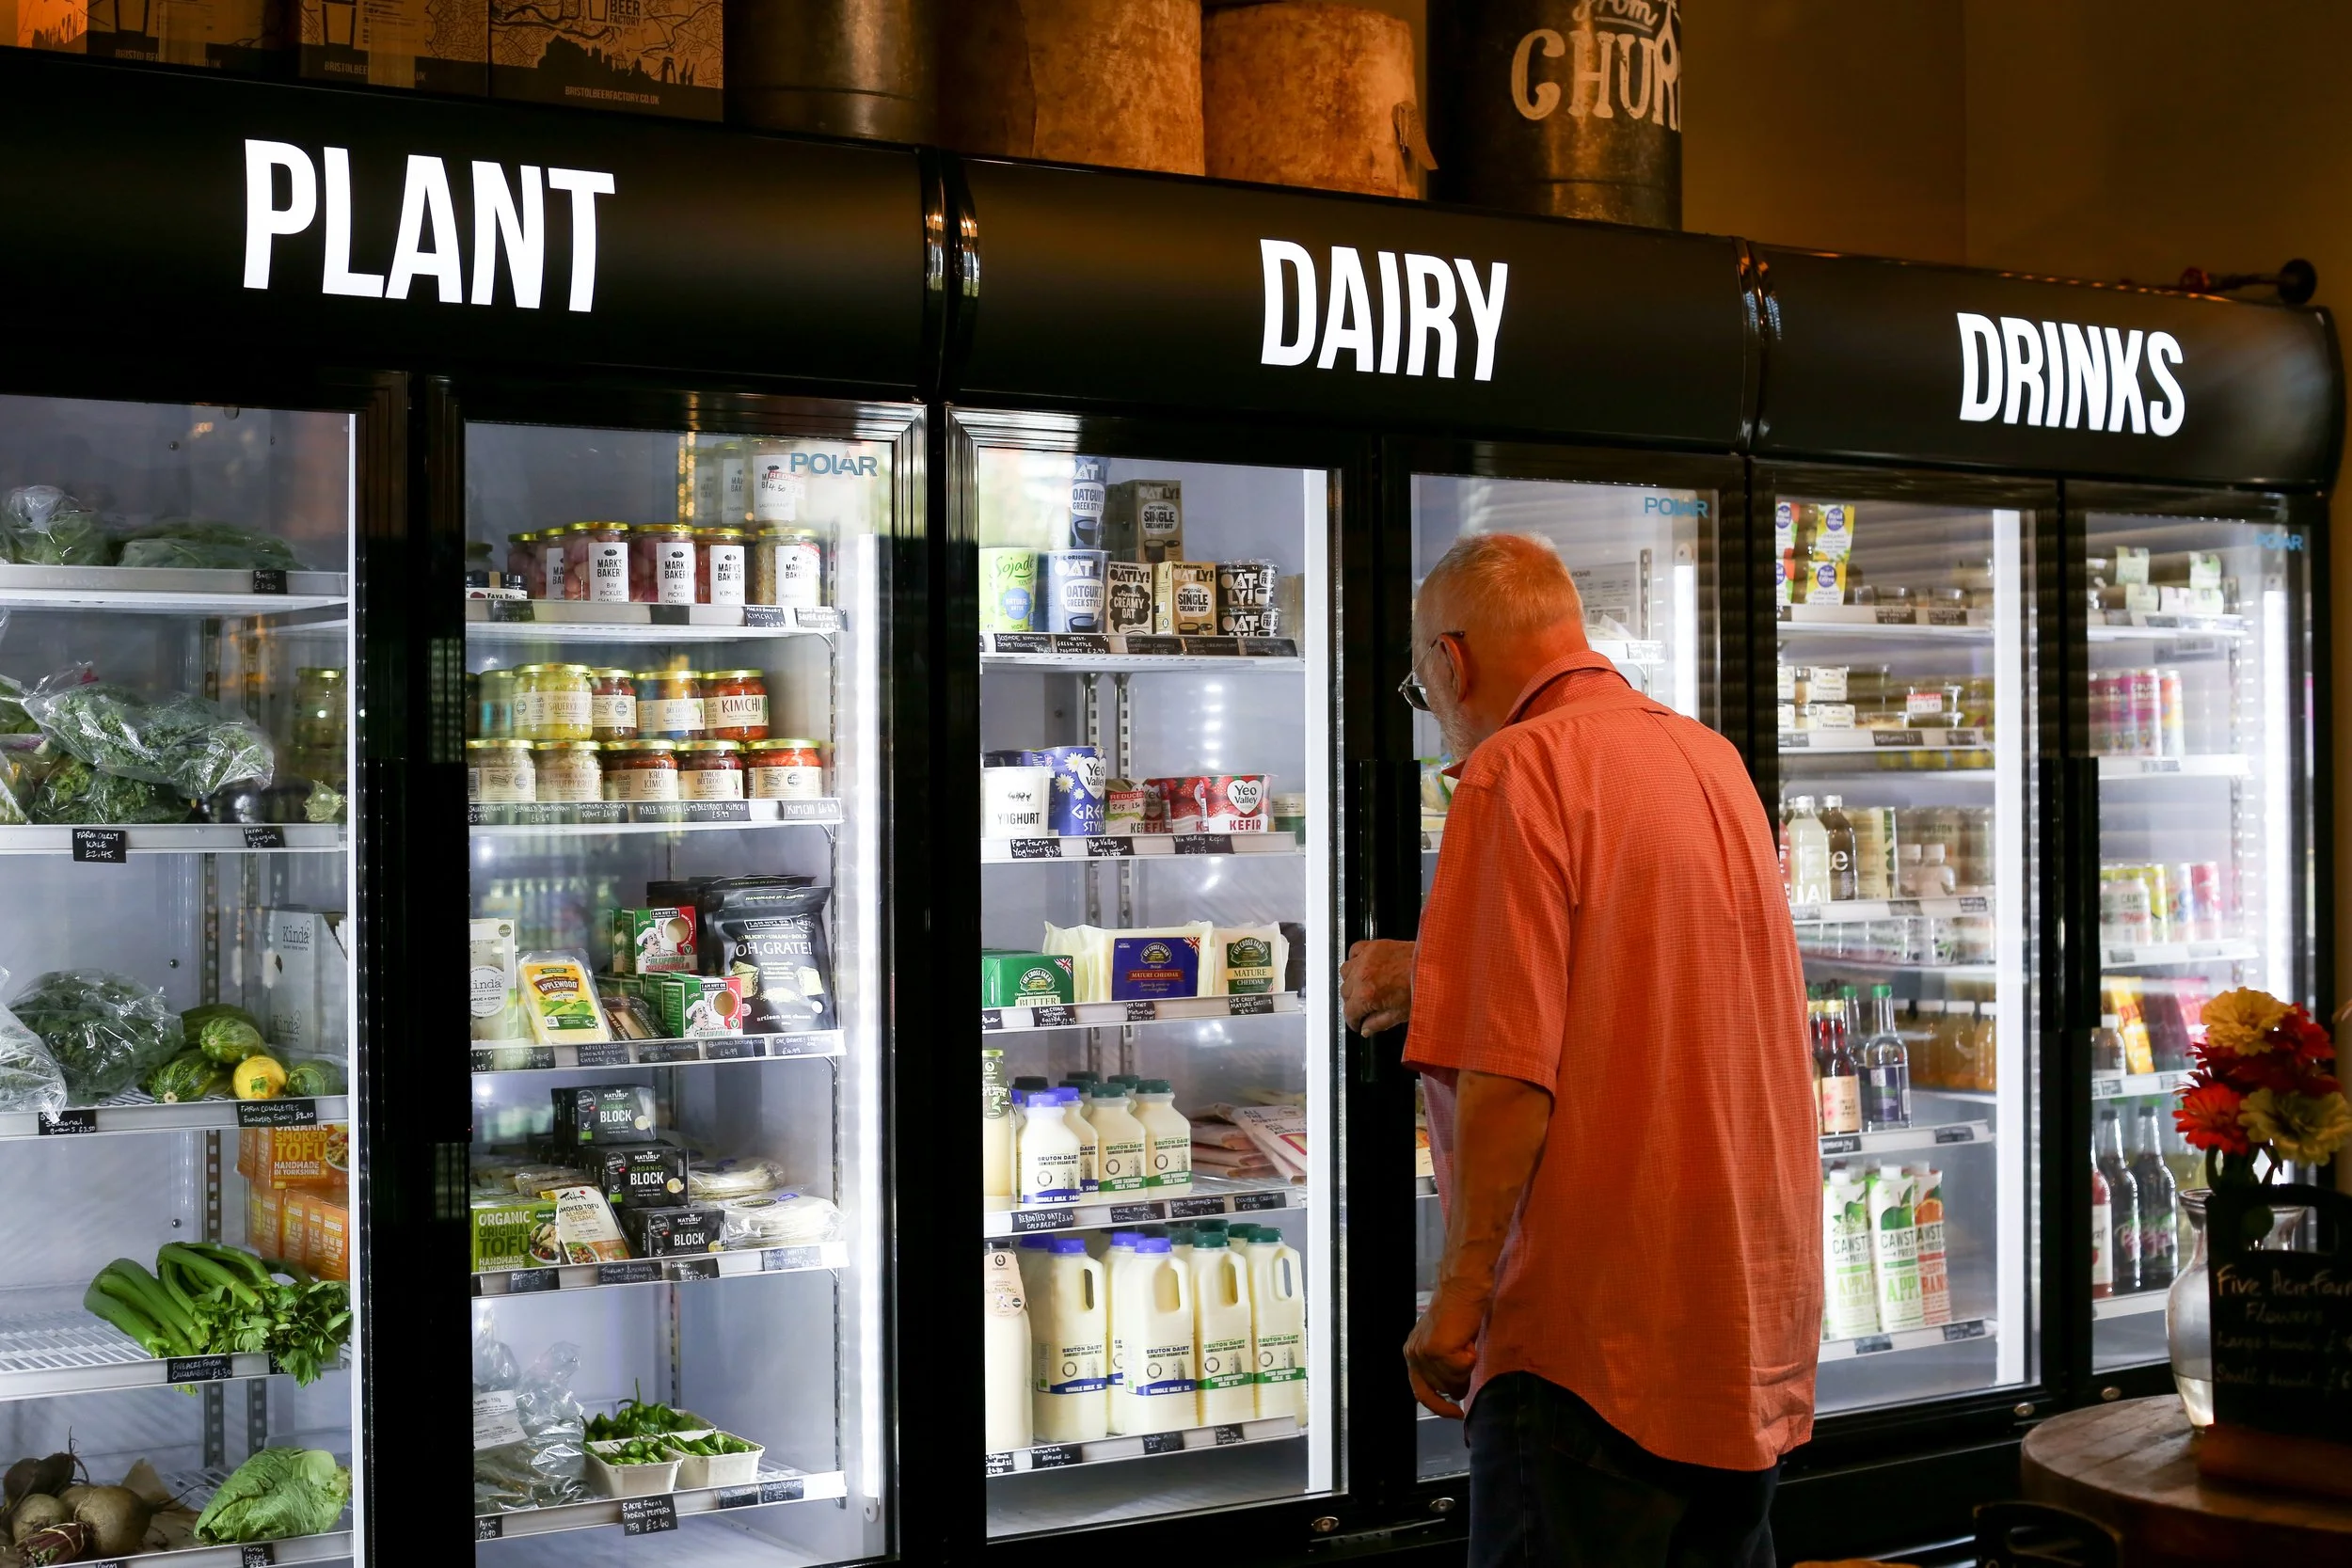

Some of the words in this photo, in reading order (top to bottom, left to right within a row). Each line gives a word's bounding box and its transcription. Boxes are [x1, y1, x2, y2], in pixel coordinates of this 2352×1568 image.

[610, 0, 640, 14] BEER
[610, 15, 641, 26] FACTORY
[1511, 29, 1681, 133] CHUR
[244, 138, 616, 313] PLANT
[1260, 239, 1509, 382] DAIRY
[1956, 311, 2185, 437] DRINKS
[790, 452, 878, 477] POLAR
[1073, 501, 1090, 510] GREEK
[1645, 497, 1709, 518] POLAR
[1144, 511, 1175, 523] SINGLE
[1109, 569, 1151, 583] OATLY!
[1173, 570, 1214, 582] OATLY!
[1066, 585, 1103, 598] OATGURT
[1067, 598, 1086, 608] GREEK
[1086, 598, 1102, 608] STYLE
[1114, 597, 1144, 610] CREAMY
[1178, 594, 1209, 606] SINGLE
[1121, 609, 1136, 619] OAT
[722, 697, 761, 713] KIMCHI
[1087, 763, 1105, 777] Yeo
[1086, 776, 1104, 786] Valley
[1234, 784, 1257, 796] Yeo
[1234, 795, 1258, 805] Valley
[640, 805, 657, 815] KALE
[787, 804, 815, 815] KIMCHI
[1230, 819, 1262, 831] KEFIR
[87, 840, 107, 848] KALE
[1088, 839, 1099, 847] Yeo
[1099, 838, 1118, 847] Valley
[282, 926, 310, 945] Kinda
[736, 942, 763, 957] OH,
[763, 942, 813, 955] GRATE!
[1148, 943, 1160, 952] CROSS
[1239, 939, 1253, 947] CROSS
[1253, 940, 1265, 954] FARM
[1027, 969, 1041, 979] CROSS
[1041, 970, 1052, 983] FARM
[1234, 969, 1266, 977] MATURE
[540, 977, 578, 991] APPLEWOOD
[1019, 997, 1057, 1006] BUTTER
[600, 1110, 632, 1123] BLOCK
[275, 1132, 328, 1143] SMOKED
[275, 1142, 326, 1162] TOFU
[274, 1161, 320, 1169] HANDMADE
[630, 1172, 664, 1185] BLOCK
[1235, 1196, 1257, 1204] DOUBLE
[479, 1211, 531, 1227] ORGANIC
[1047, 1212, 1057, 1221] OAT
[479, 1223, 531, 1238] ORIGINAL
[675, 1232, 706, 1246] BLOCK
[479, 1236, 531, 1257] TOFU
[479, 1255, 524, 1266] HANDMADE
[487, 1263, 524, 1272] YORKSHIRE
[2217, 1263, 2262, 1296] Five
[2245, 1302, 2323, 1325] Flowers
[624, 1511, 646, 1519] PADRON
